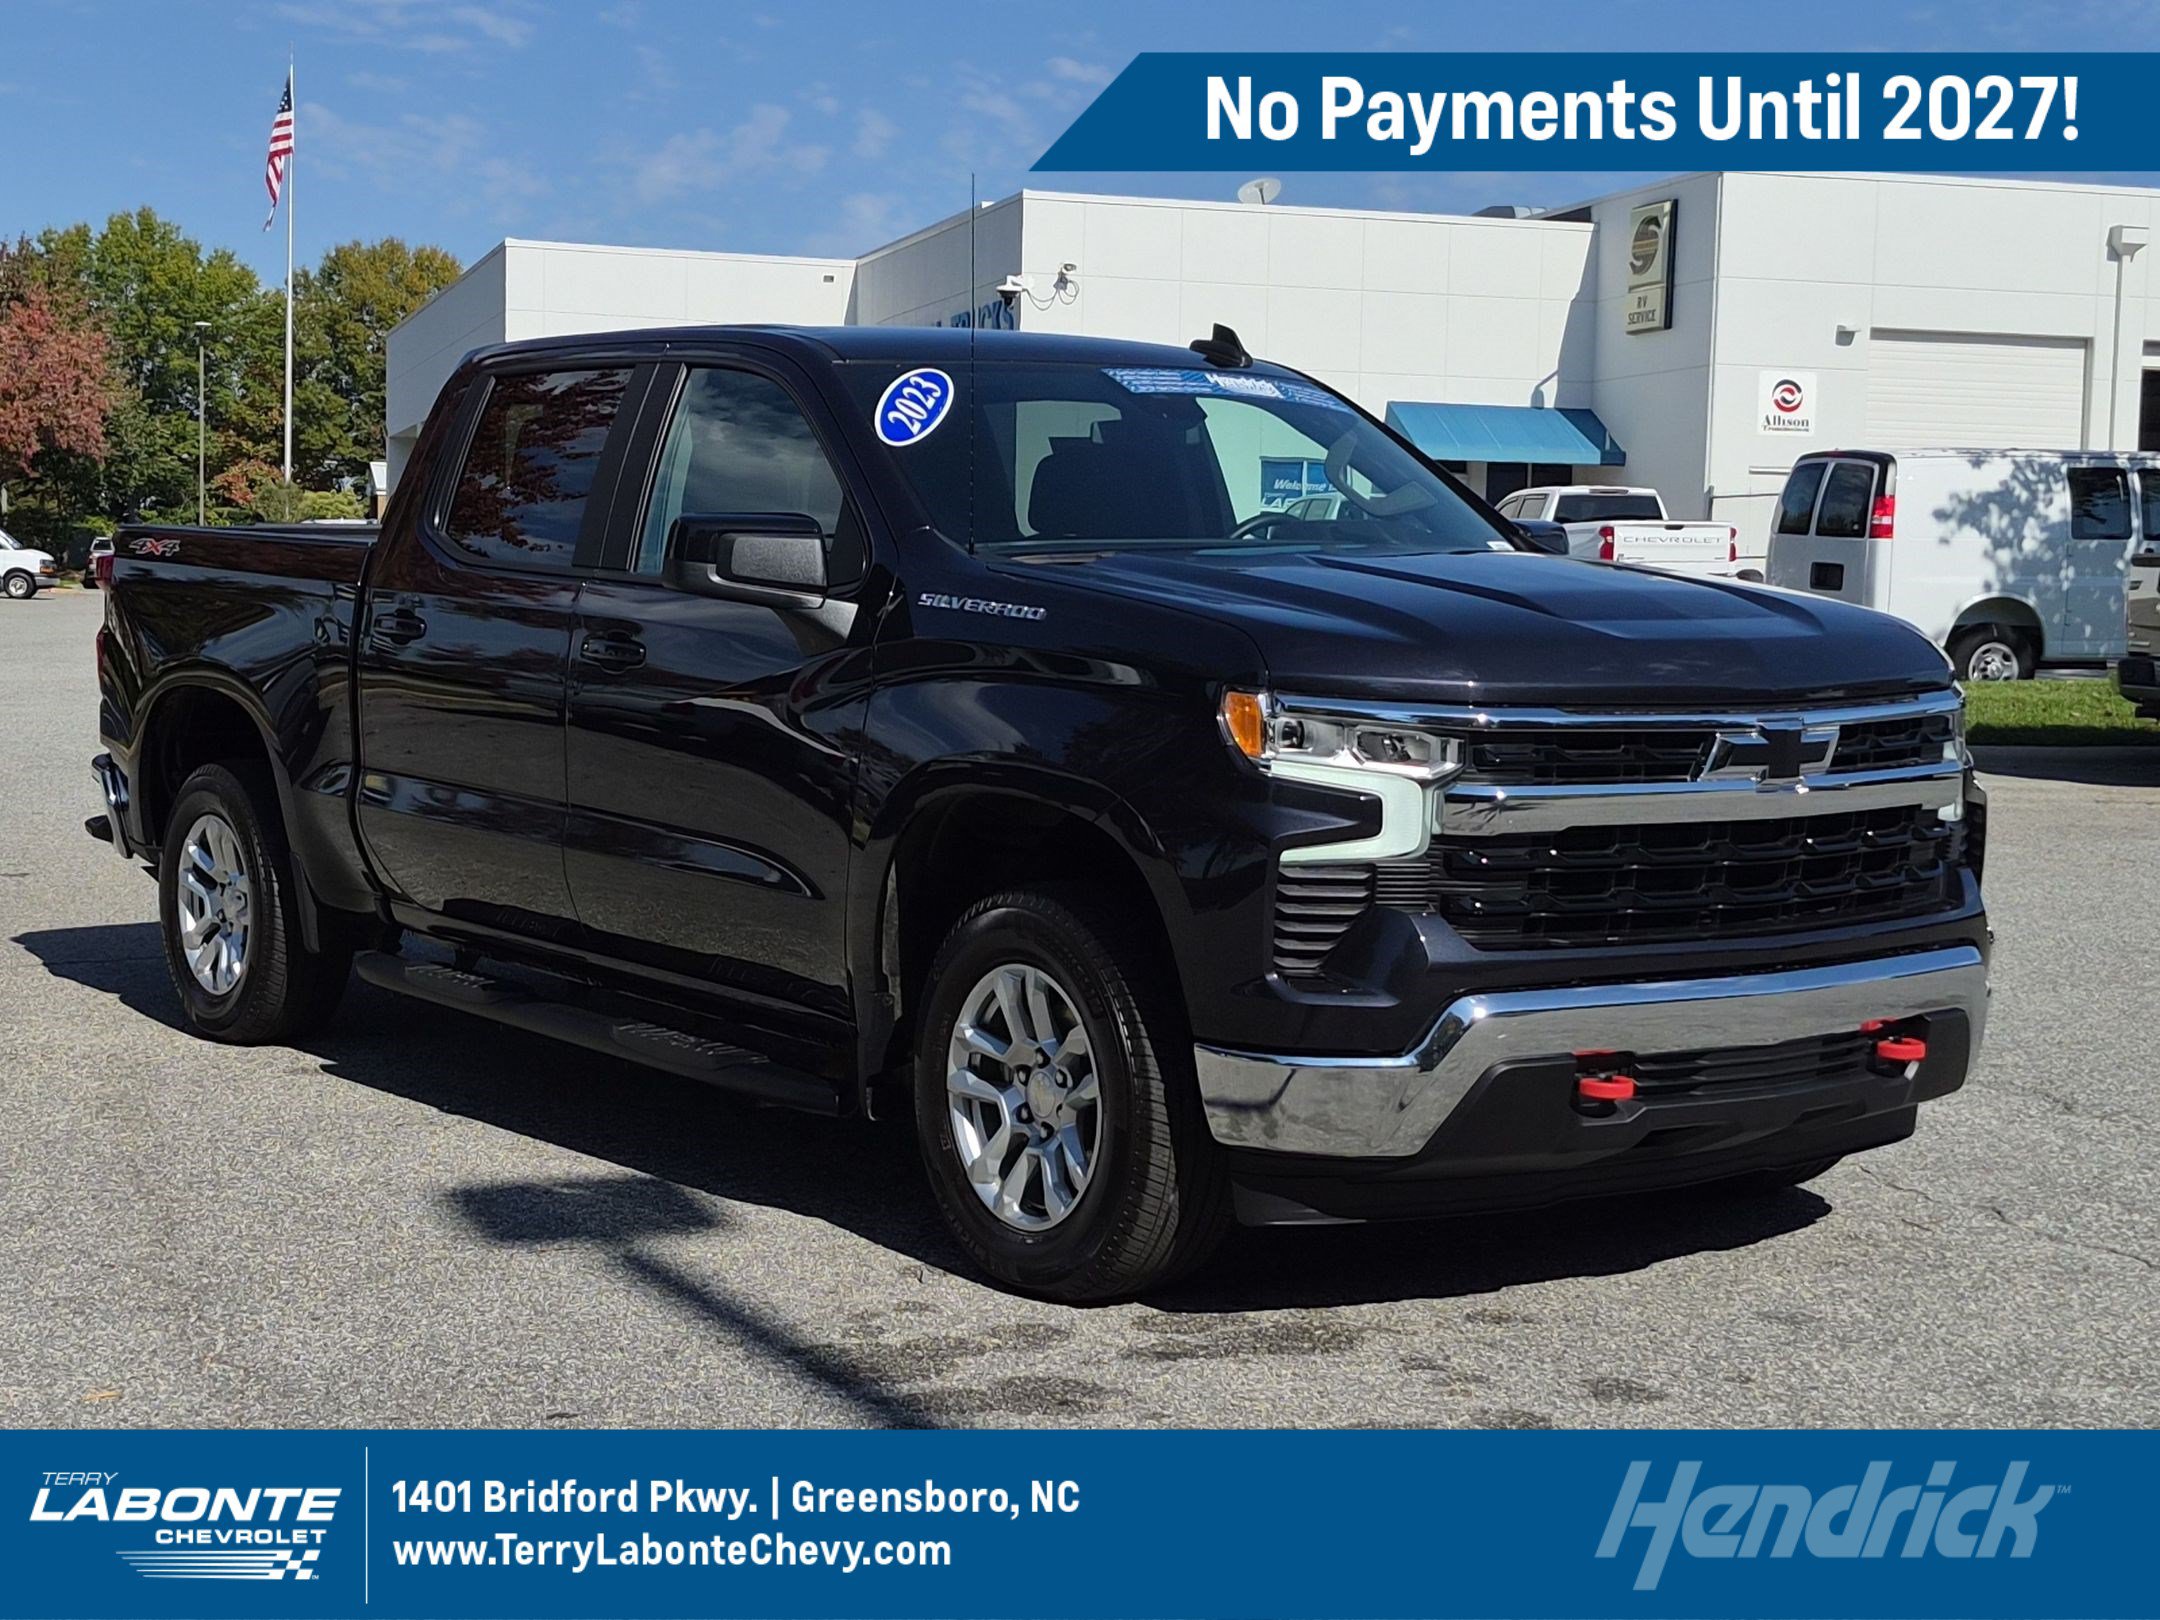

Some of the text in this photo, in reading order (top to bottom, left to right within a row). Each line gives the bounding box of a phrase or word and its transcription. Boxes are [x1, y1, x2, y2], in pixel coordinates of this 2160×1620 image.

[1636, 295, 1648, 308] RV
[1627, 309, 1657, 325] SERVICE
[888, 375, 942, 436] 2023
[1764, 414, 1810, 427] Allison
[1623, 536, 1723, 544] CHEVROLET
[918, 592, 1048, 621] SILVERADO
